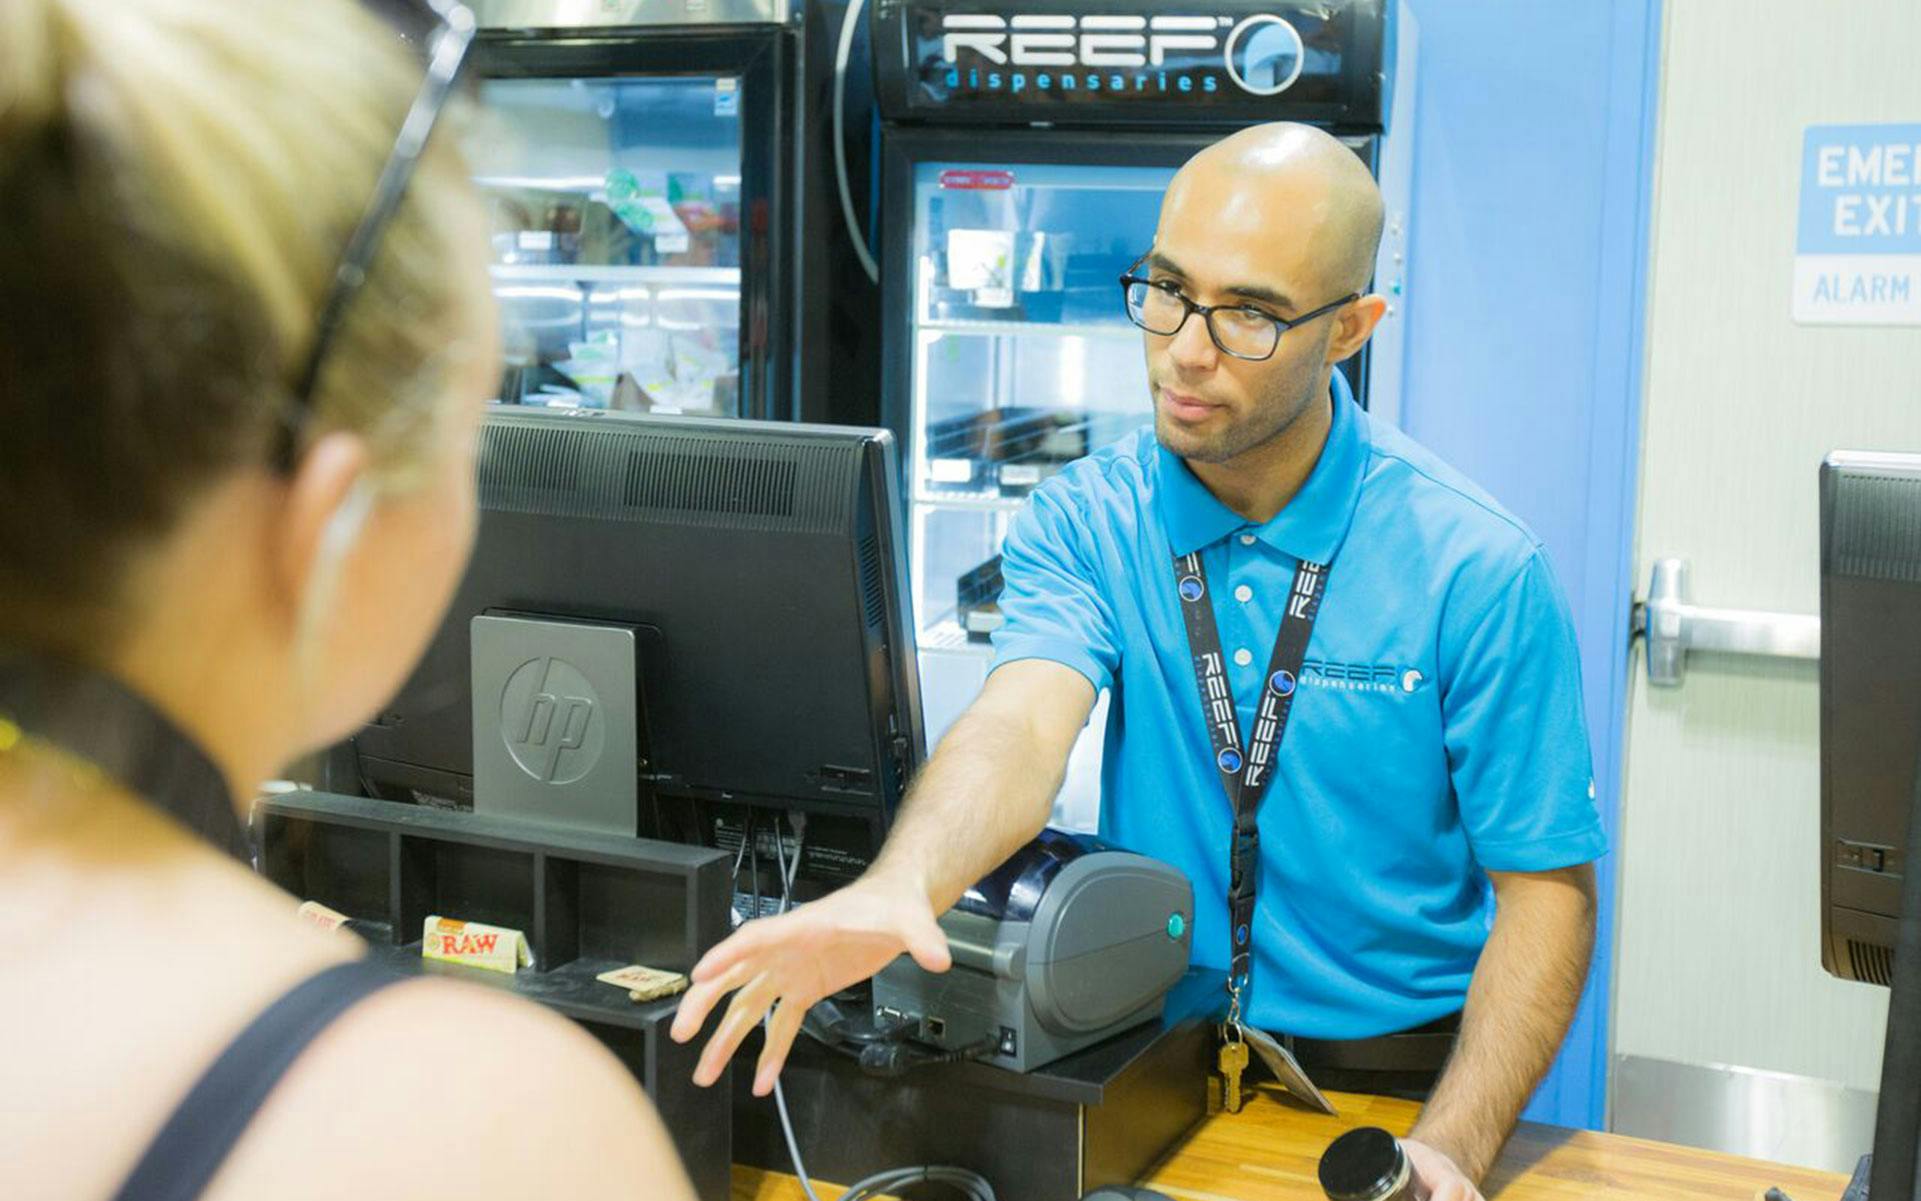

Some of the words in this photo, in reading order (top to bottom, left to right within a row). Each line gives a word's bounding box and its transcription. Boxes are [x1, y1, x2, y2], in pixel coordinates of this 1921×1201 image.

[945, 71, 1218, 94] dispensaries
[1818, 144, 1921, 187] EME
[1813, 272, 1910, 302] ALARM
[1301, 660, 1395, 681] REEF
[1202, 652, 1239, 746] REEF
[516, 657, 593, 782] hp
[1245, 693, 1278, 786] REEF
[442, 933, 498, 955] RAW
